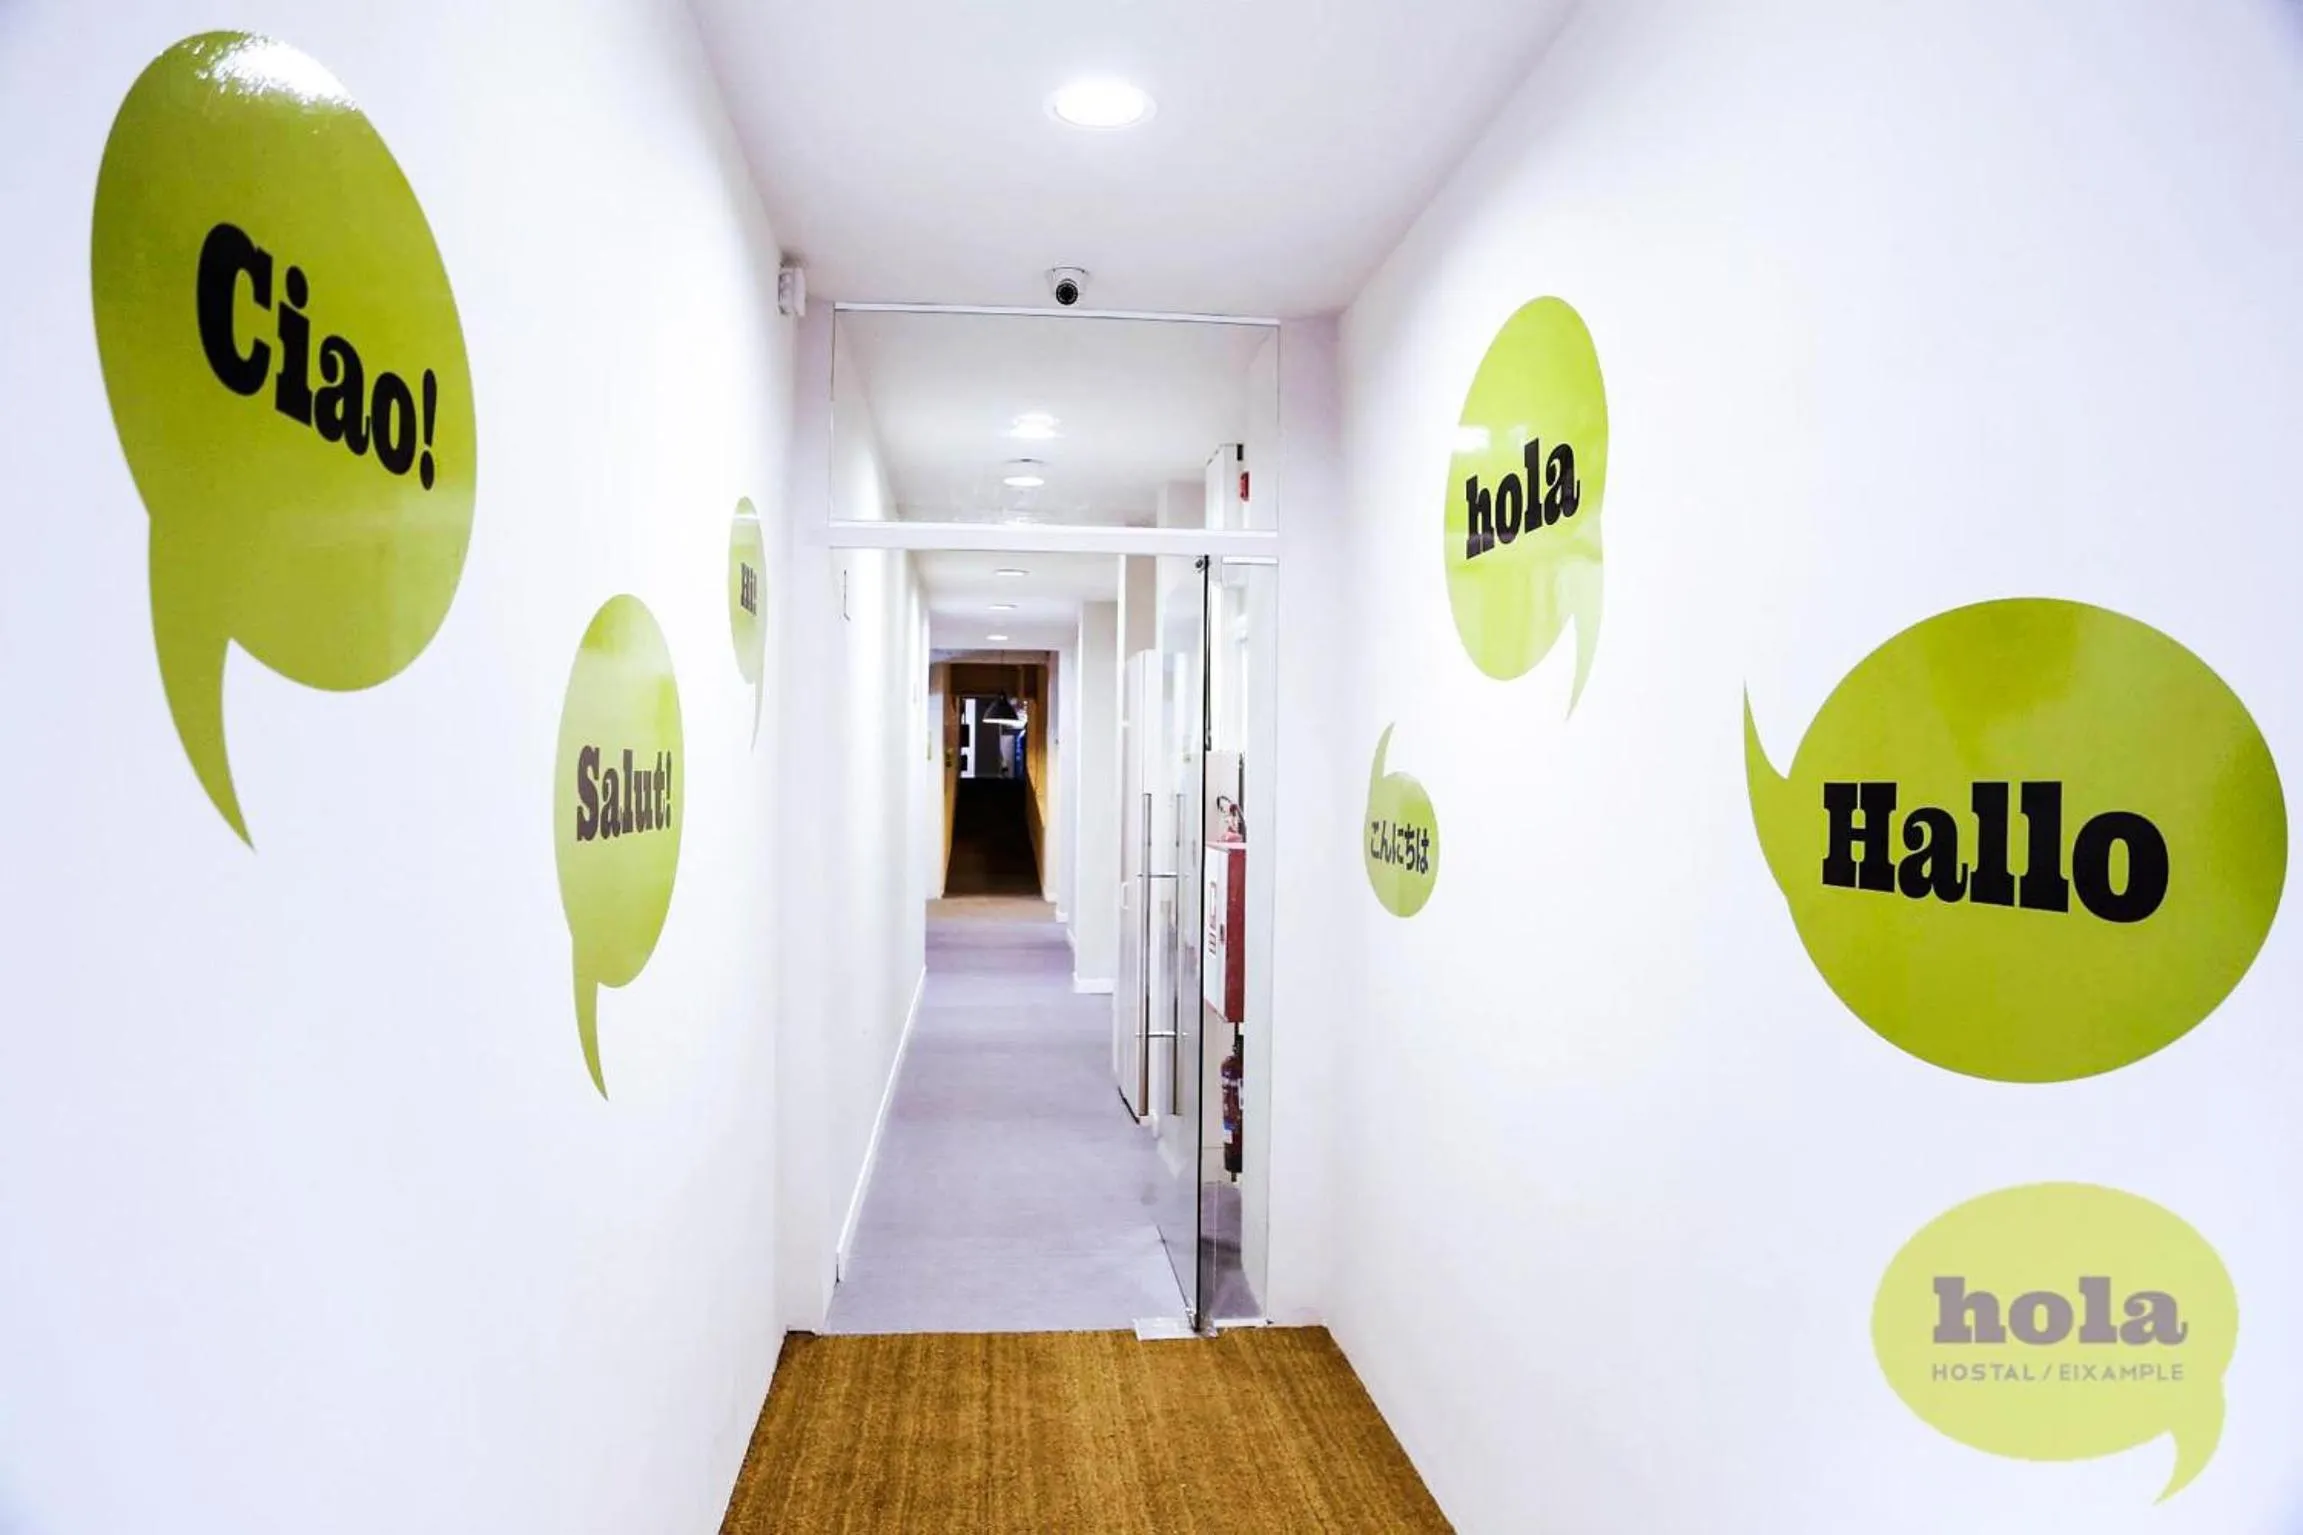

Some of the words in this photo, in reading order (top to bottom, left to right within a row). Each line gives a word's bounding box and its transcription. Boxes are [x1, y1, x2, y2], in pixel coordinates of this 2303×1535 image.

[195, 221, 438, 491] Ciao!
[1465, 437, 1581, 560] hola
[576, 745, 672, 842] Salut!
[1370, 820, 1430, 875] こんにちは
[1822, 780, 2170, 924] Hallo
